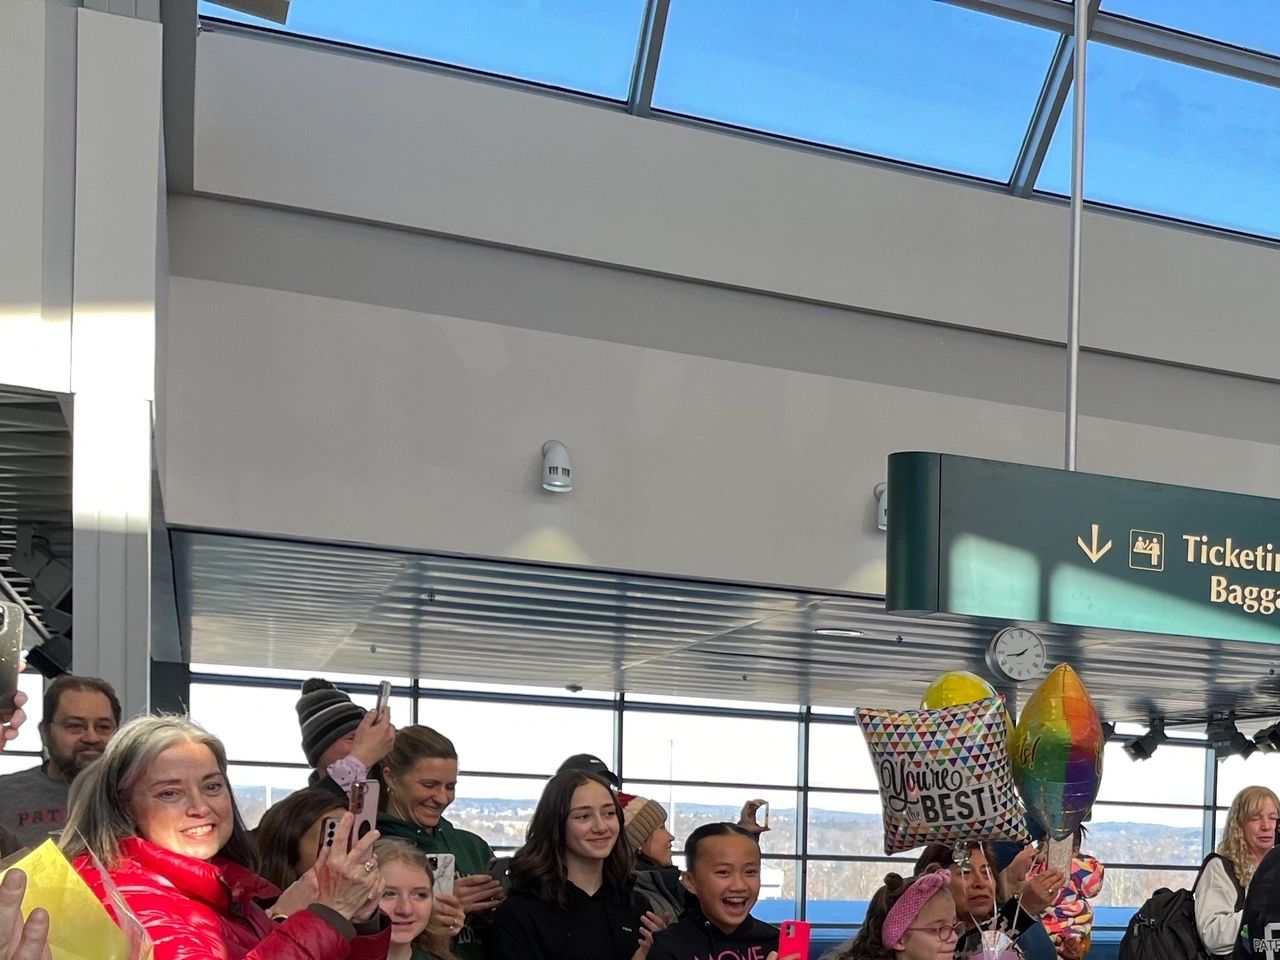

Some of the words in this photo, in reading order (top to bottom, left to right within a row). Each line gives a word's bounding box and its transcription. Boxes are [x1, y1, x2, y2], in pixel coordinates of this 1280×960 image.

[880, 758, 963, 812] You're
[920, 784, 999, 824] BEST!
[16, 808, 63, 828] PAT
